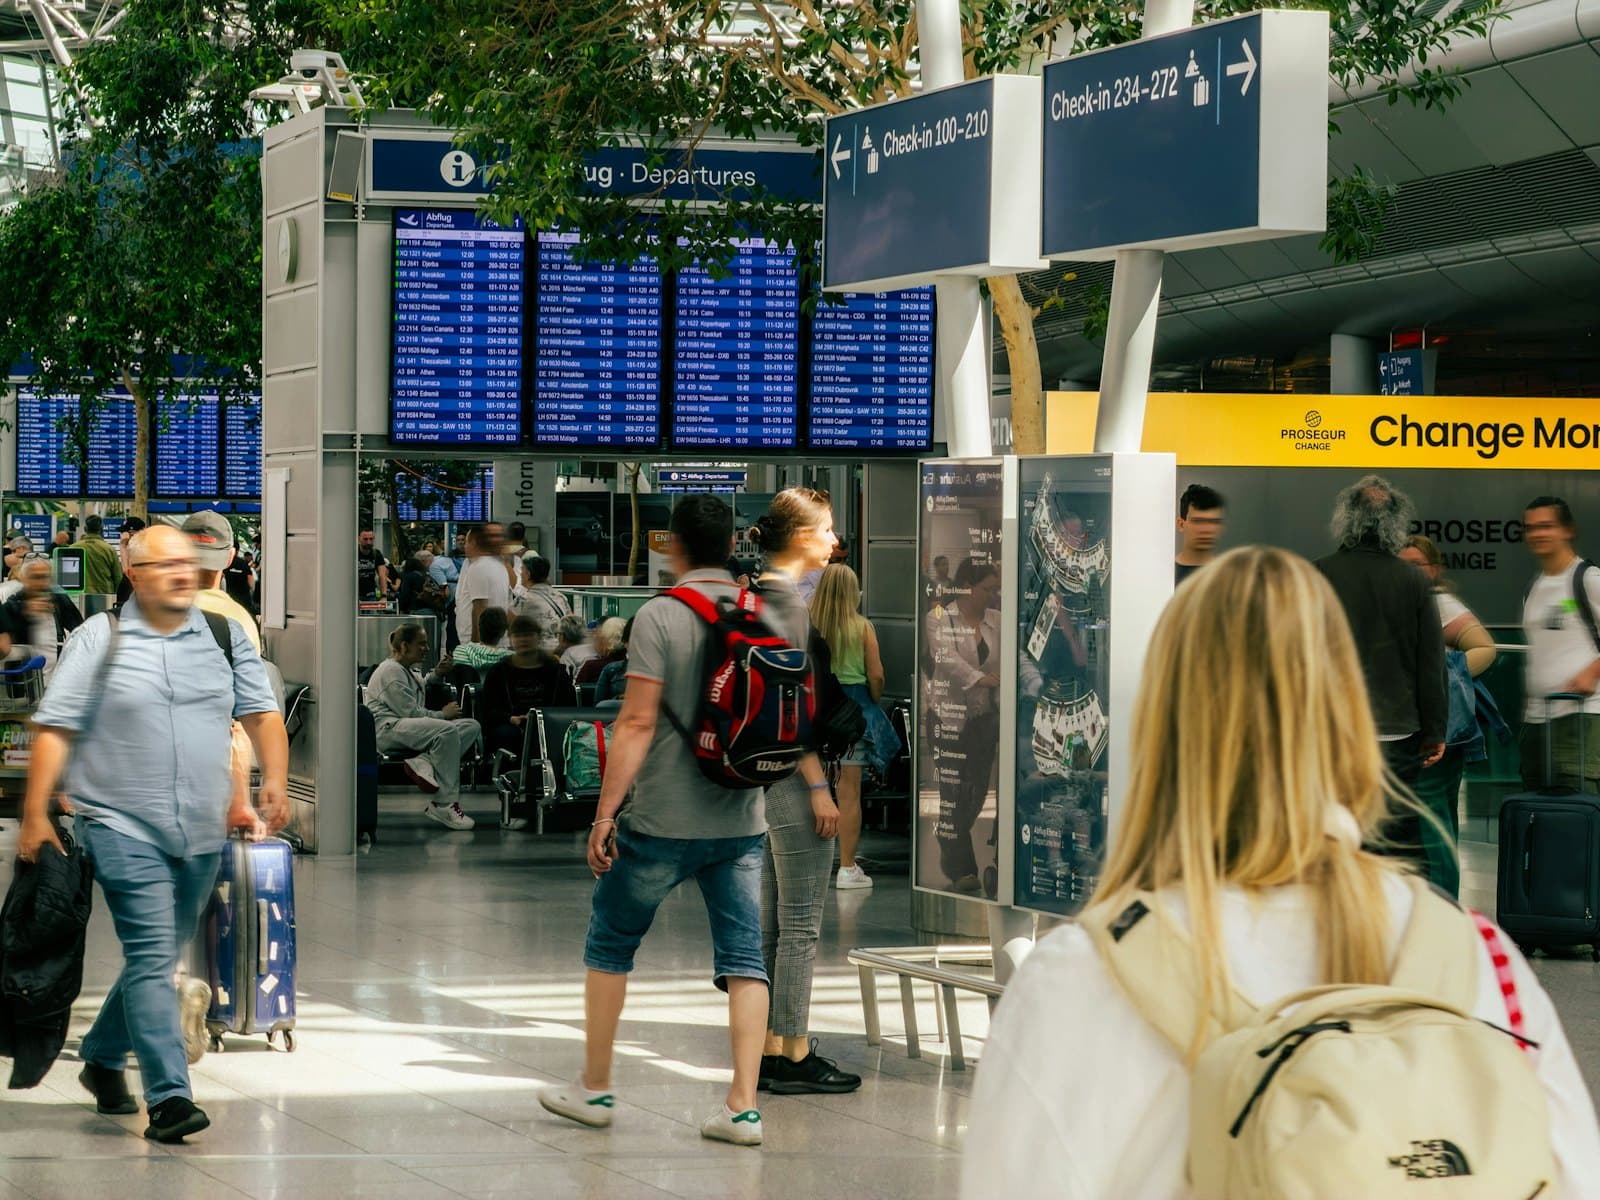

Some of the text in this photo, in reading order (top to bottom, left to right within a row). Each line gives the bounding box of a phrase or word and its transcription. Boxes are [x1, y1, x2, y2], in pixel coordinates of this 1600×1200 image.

[1051, 82, 1111, 122] Check-in
[883, 122, 932, 157] Check-in
[632, 163, 756, 189] Departures
[426, 213, 452, 223] Abflug
[1281, 429, 1346, 440] PROSEGUR
[1295, 442, 1331, 451] CHANGE
[1370, 414, 1524, 459] Change
[1410, 520, 1523, 544] PROSEG
[1442, 552, 1497, 570] ANGE
[710, 660, 736, 703] Wilson
[756, 760, 797, 772] Wilson
